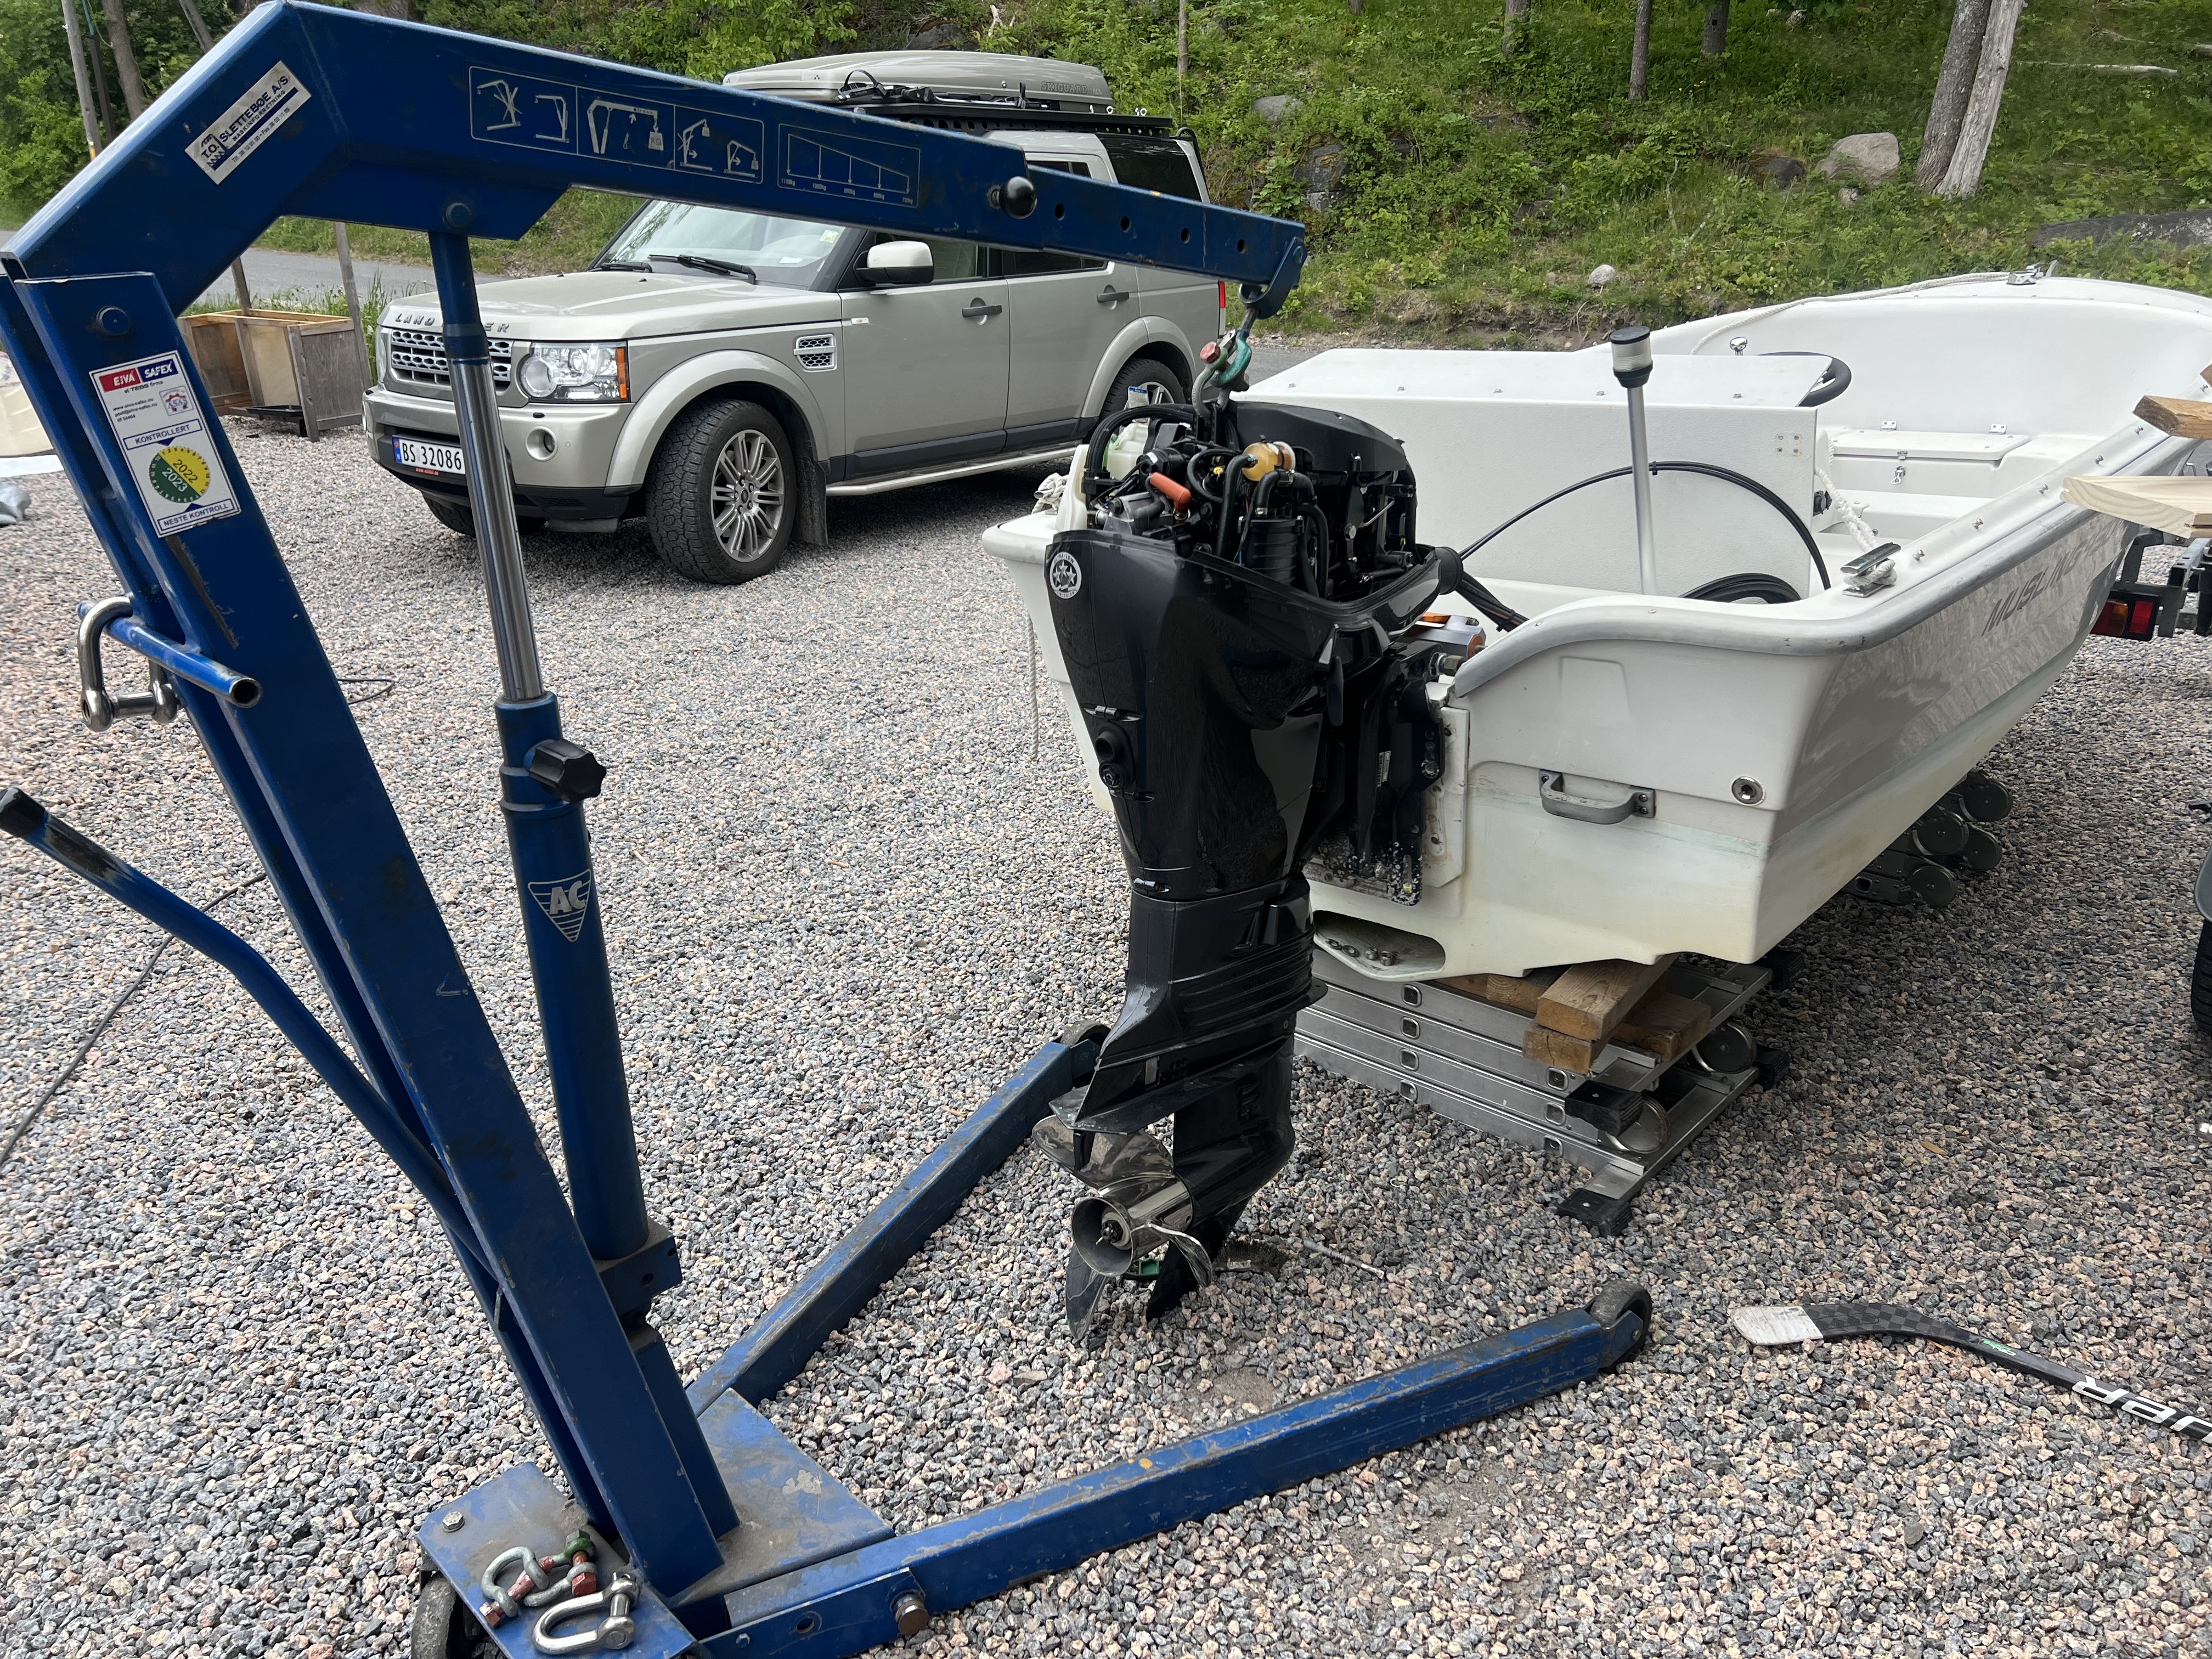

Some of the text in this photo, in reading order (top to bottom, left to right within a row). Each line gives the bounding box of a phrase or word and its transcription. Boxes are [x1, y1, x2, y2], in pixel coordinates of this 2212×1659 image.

[1041, 81, 1088, 94] SKIGUARD
[219, 92, 271, 142] SLETTEBØE
[272, 76, 289, 94] A/S
[233, 90, 285, 141] MASKINFORRETNING
[395, 313, 435, 326] LAND
[113, 362, 173, 386] EIVA SAFEX
[135, 424, 190, 444] KONTROLLERT
[402, 443, 461, 470] BS 32086
[162, 467, 188, 492] 2023
[172, 459, 198, 483] 2022
[163, 503, 229, 527] NESTE KONTROLL
[549, 880, 586, 915] AC
